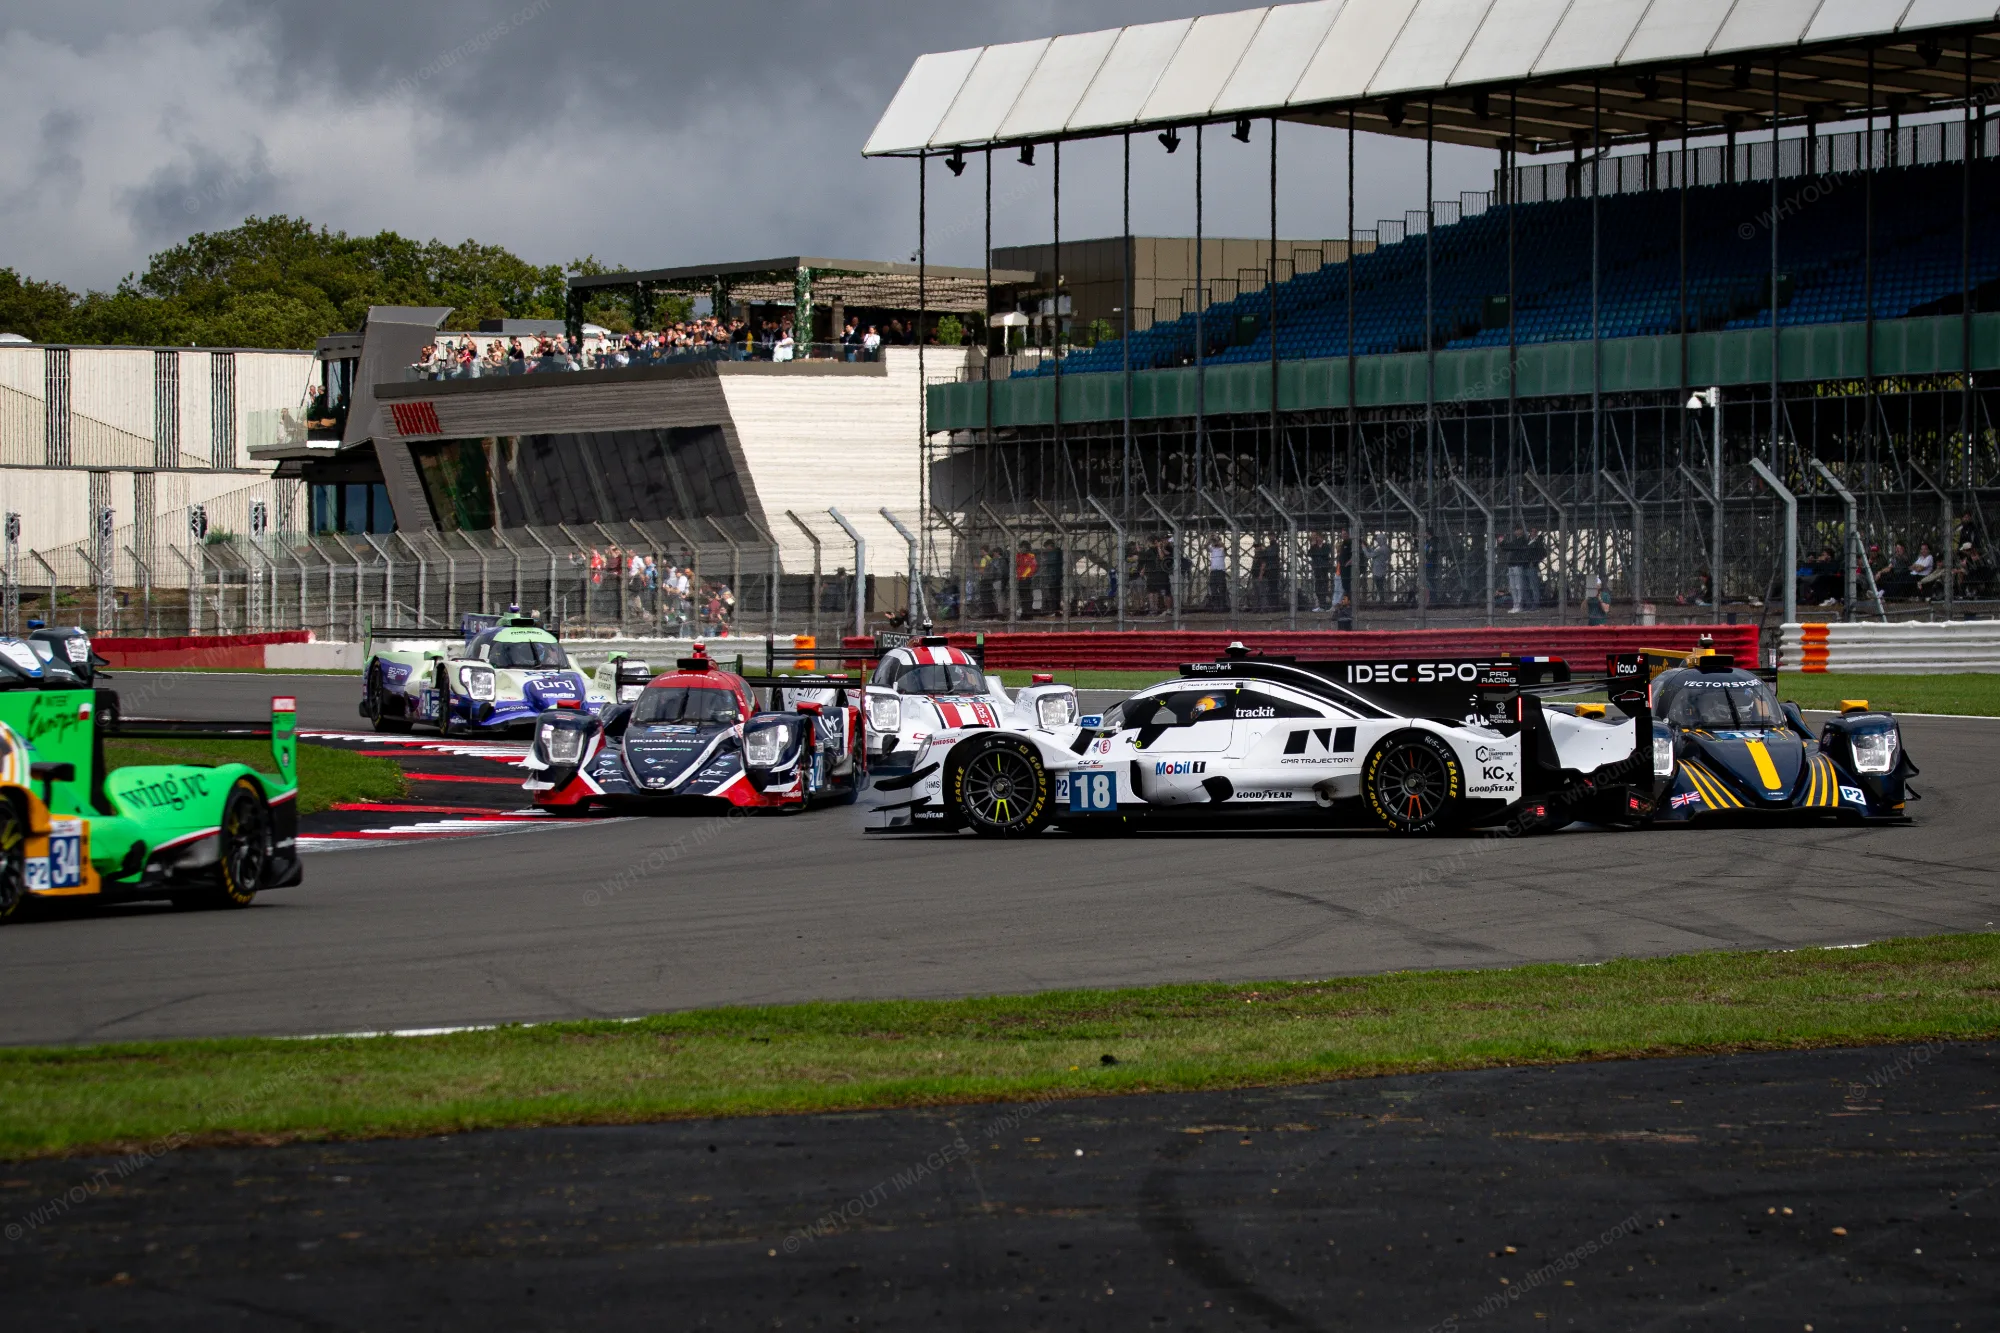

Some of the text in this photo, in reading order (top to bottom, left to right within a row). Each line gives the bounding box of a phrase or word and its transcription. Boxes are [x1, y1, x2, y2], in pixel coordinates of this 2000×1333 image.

[1348, 664, 1512, 684] IDEC.SPO
[1684, 679, 1762, 688] VECTORSPORT
[1236, 706, 1275, 718] trackit
[933, 738, 957, 746] RHEOSOL
[1156, 761, 1191, 775] Mobil
[955, 766, 965, 803] EAGLE
[1057, 779, 1068, 797] P2
[1368, 751, 1388, 820] GOODYEAR
[1446, 760, 1458, 799] EAGLE
[120, 772, 210, 811] wing.vc
[1027, 755, 1048, 825] GOODYEAR
[1074, 774, 1111, 809] 18
[1236, 789, 1293, 800] GOODYEAR
[1469, 784, 1515, 798] GOODYEAR
[1843, 788, 1864, 802] P2
[914, 810, 944, 819] GOODYEAR
[51, 837, 80, 885] 34
[26, 862, 48, 885] P2
